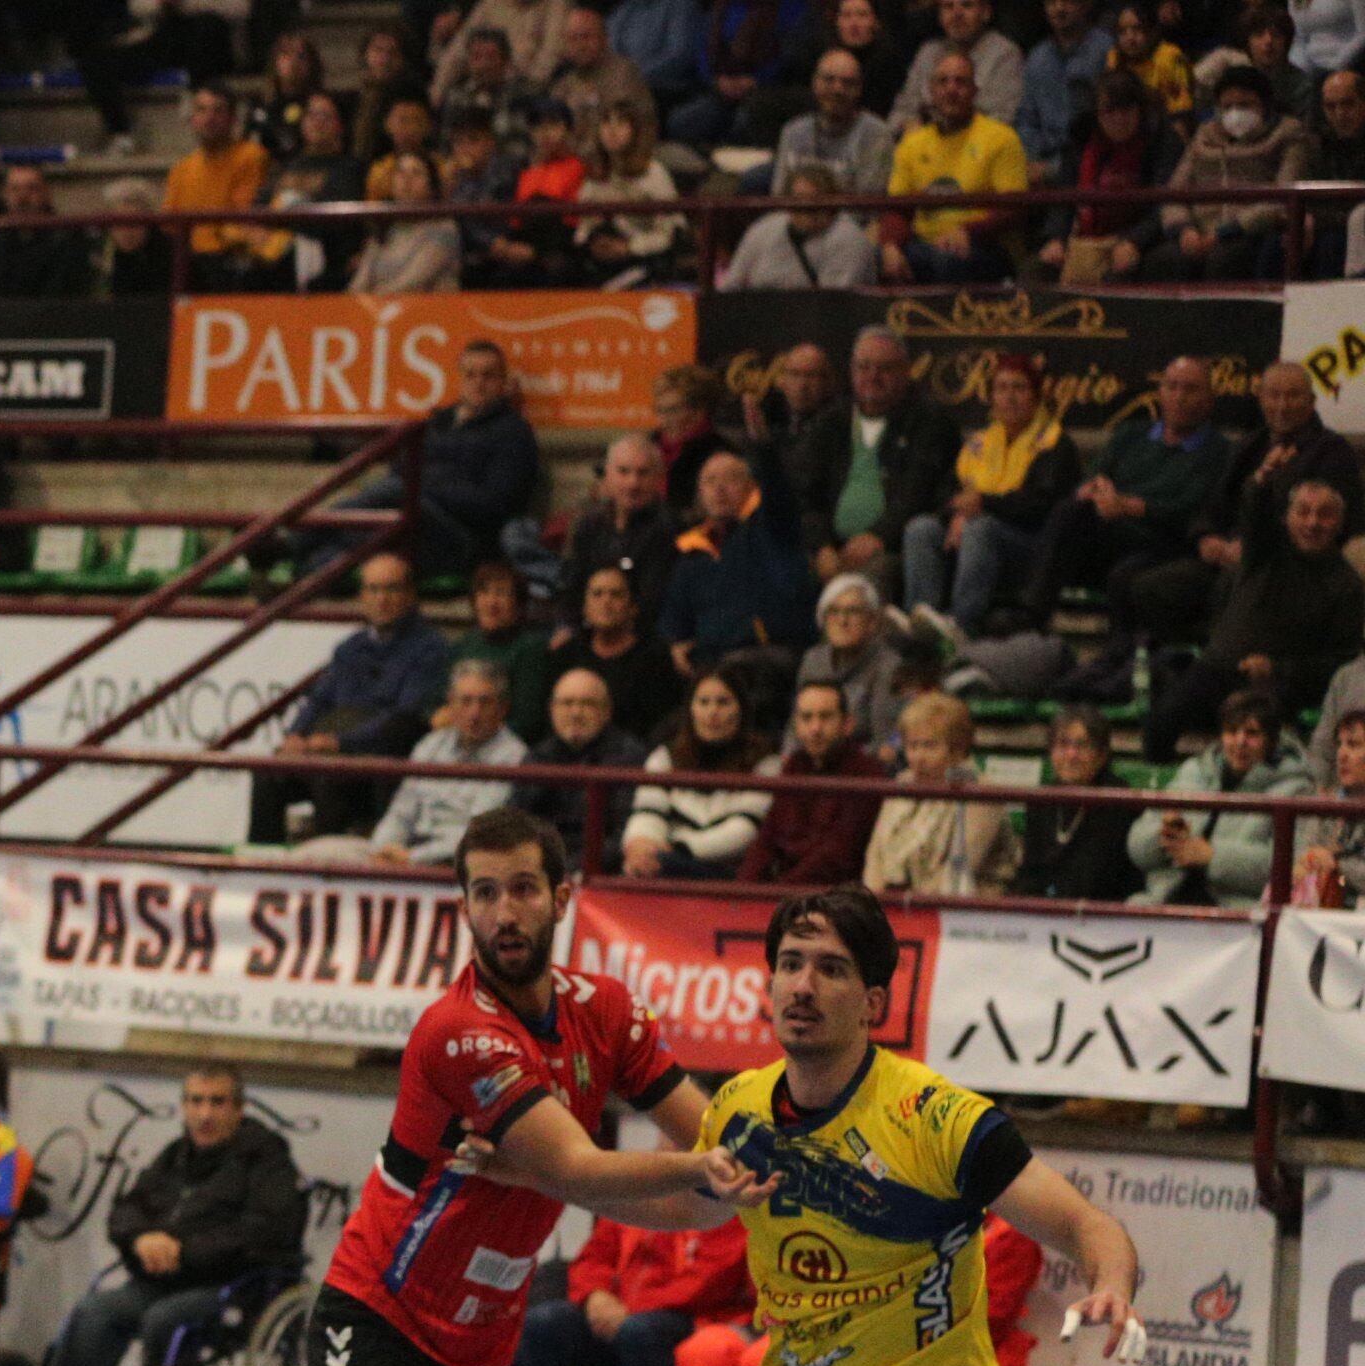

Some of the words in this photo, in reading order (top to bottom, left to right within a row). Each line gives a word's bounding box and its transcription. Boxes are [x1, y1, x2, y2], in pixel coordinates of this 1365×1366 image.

[188, 302, 450, 412] PARÍS
[43, 872, 218, 974] CASA
[244, 888, 465, 992] SILVIA
[946, 998, 1237, 1078] AJAX
